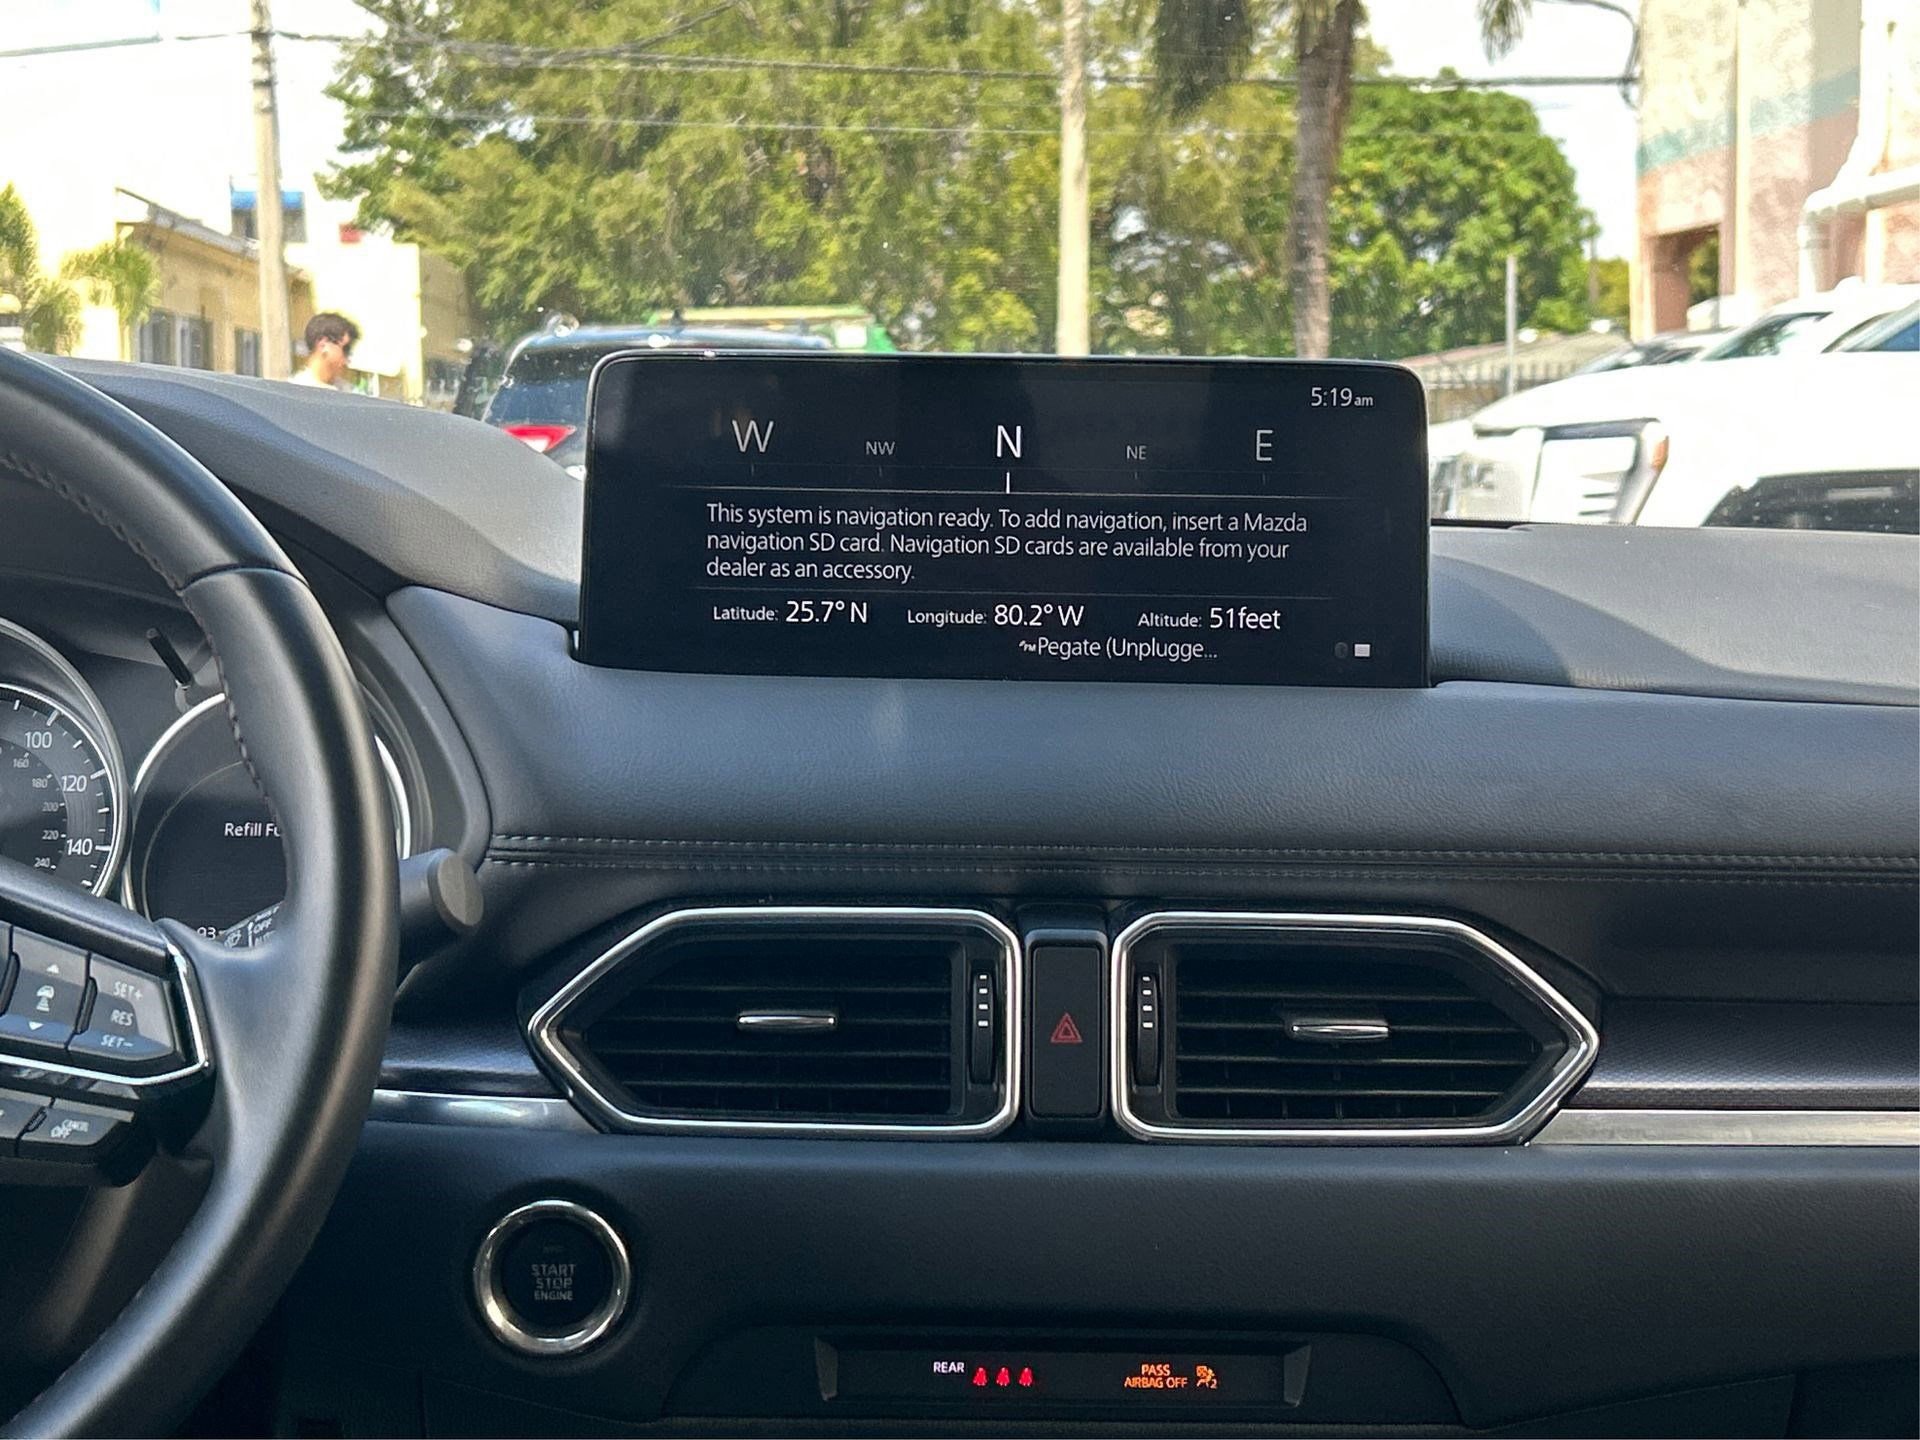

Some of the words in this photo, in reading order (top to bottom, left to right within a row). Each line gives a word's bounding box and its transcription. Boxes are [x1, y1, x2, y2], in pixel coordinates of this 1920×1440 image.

[732, 420, 773, 452] W
[866, 442, 895, 455] NW
[997, 425, 1021, 457] N
[1127, 446, 1145, 459] NE
[1256, 430, 1273, 461] E
[707, 502, 743, 522] This
[748, 506, 812, 528] system
[819, 506, 831, 524] is
[837, 507, 932, 530] navigation
[939, 508, 993, 531] ready.
[999, 509, 1020, 527] To
[1025, 509, 1060, 528] add
[1067, 511, 1166, 533] navigation,
[1173, 512, 1223, 530] insert
[1228, 517, 1238, 531] a
[1245, 512, 1306, 531] Mazda
[707, 531, 804, 554] navigation
[810, 533, 835, 551] SD
[840, 532, 884, 552] card.
[891, 534, 989, 557] Navigation
[995, 536, 1020, 554] SD
[1025, 536, 1074, 555] cards
[1079, 541, 1108, 555] are
[1113, 537, 1193, 557] available
[1199, 537, 1242, 557] from
[1247, 544, 1289, 562] your
[707, 556, 766, 577] dealer
[770, 563, 790, 577] as
[795, 563, 817, 577] an
[823, 564, 914, 584] accessory.
[714, 606, 778, 620] Latitude:
[786, 601, 844, 622] 25.7°
[851, 602, 866, 623] N
[908, 609, 986, 627] Longitude:
[995, 604, 1053, 626] 80.2°
[1058, 606, 1084, 626] W
[1138, 613, 1201, 627] Altitude:
[1211, 607, 1280, 629] 51feet
[1039, 637, 1101, 660] Pegate
[25, 732, 52, 748] 100
[62, 775, 87, 792] 120
[42, 801, 59, 812] 200
[42, 830, 59, 840] 220
[225, 822, 261, 836] Refill
[67, 839, 92, 855] 140
[34, 858, 50, 868] 240
[113, 981, 143, 1000] SET+
[111, 1009, 134, 1026] RES
[531, 1263, 576, 1276] START
[536, 1278, 573, 1288] STOP
[534, 1290, 573, 1300] ENGINE
[934, 1362, 964, 1373] REAR
[1142, 1364, 1170, 1376] PASS
[1124, 1376, 1164, 1388] AIRBAG
[1165, 1377, 1187, 1388] OFF
